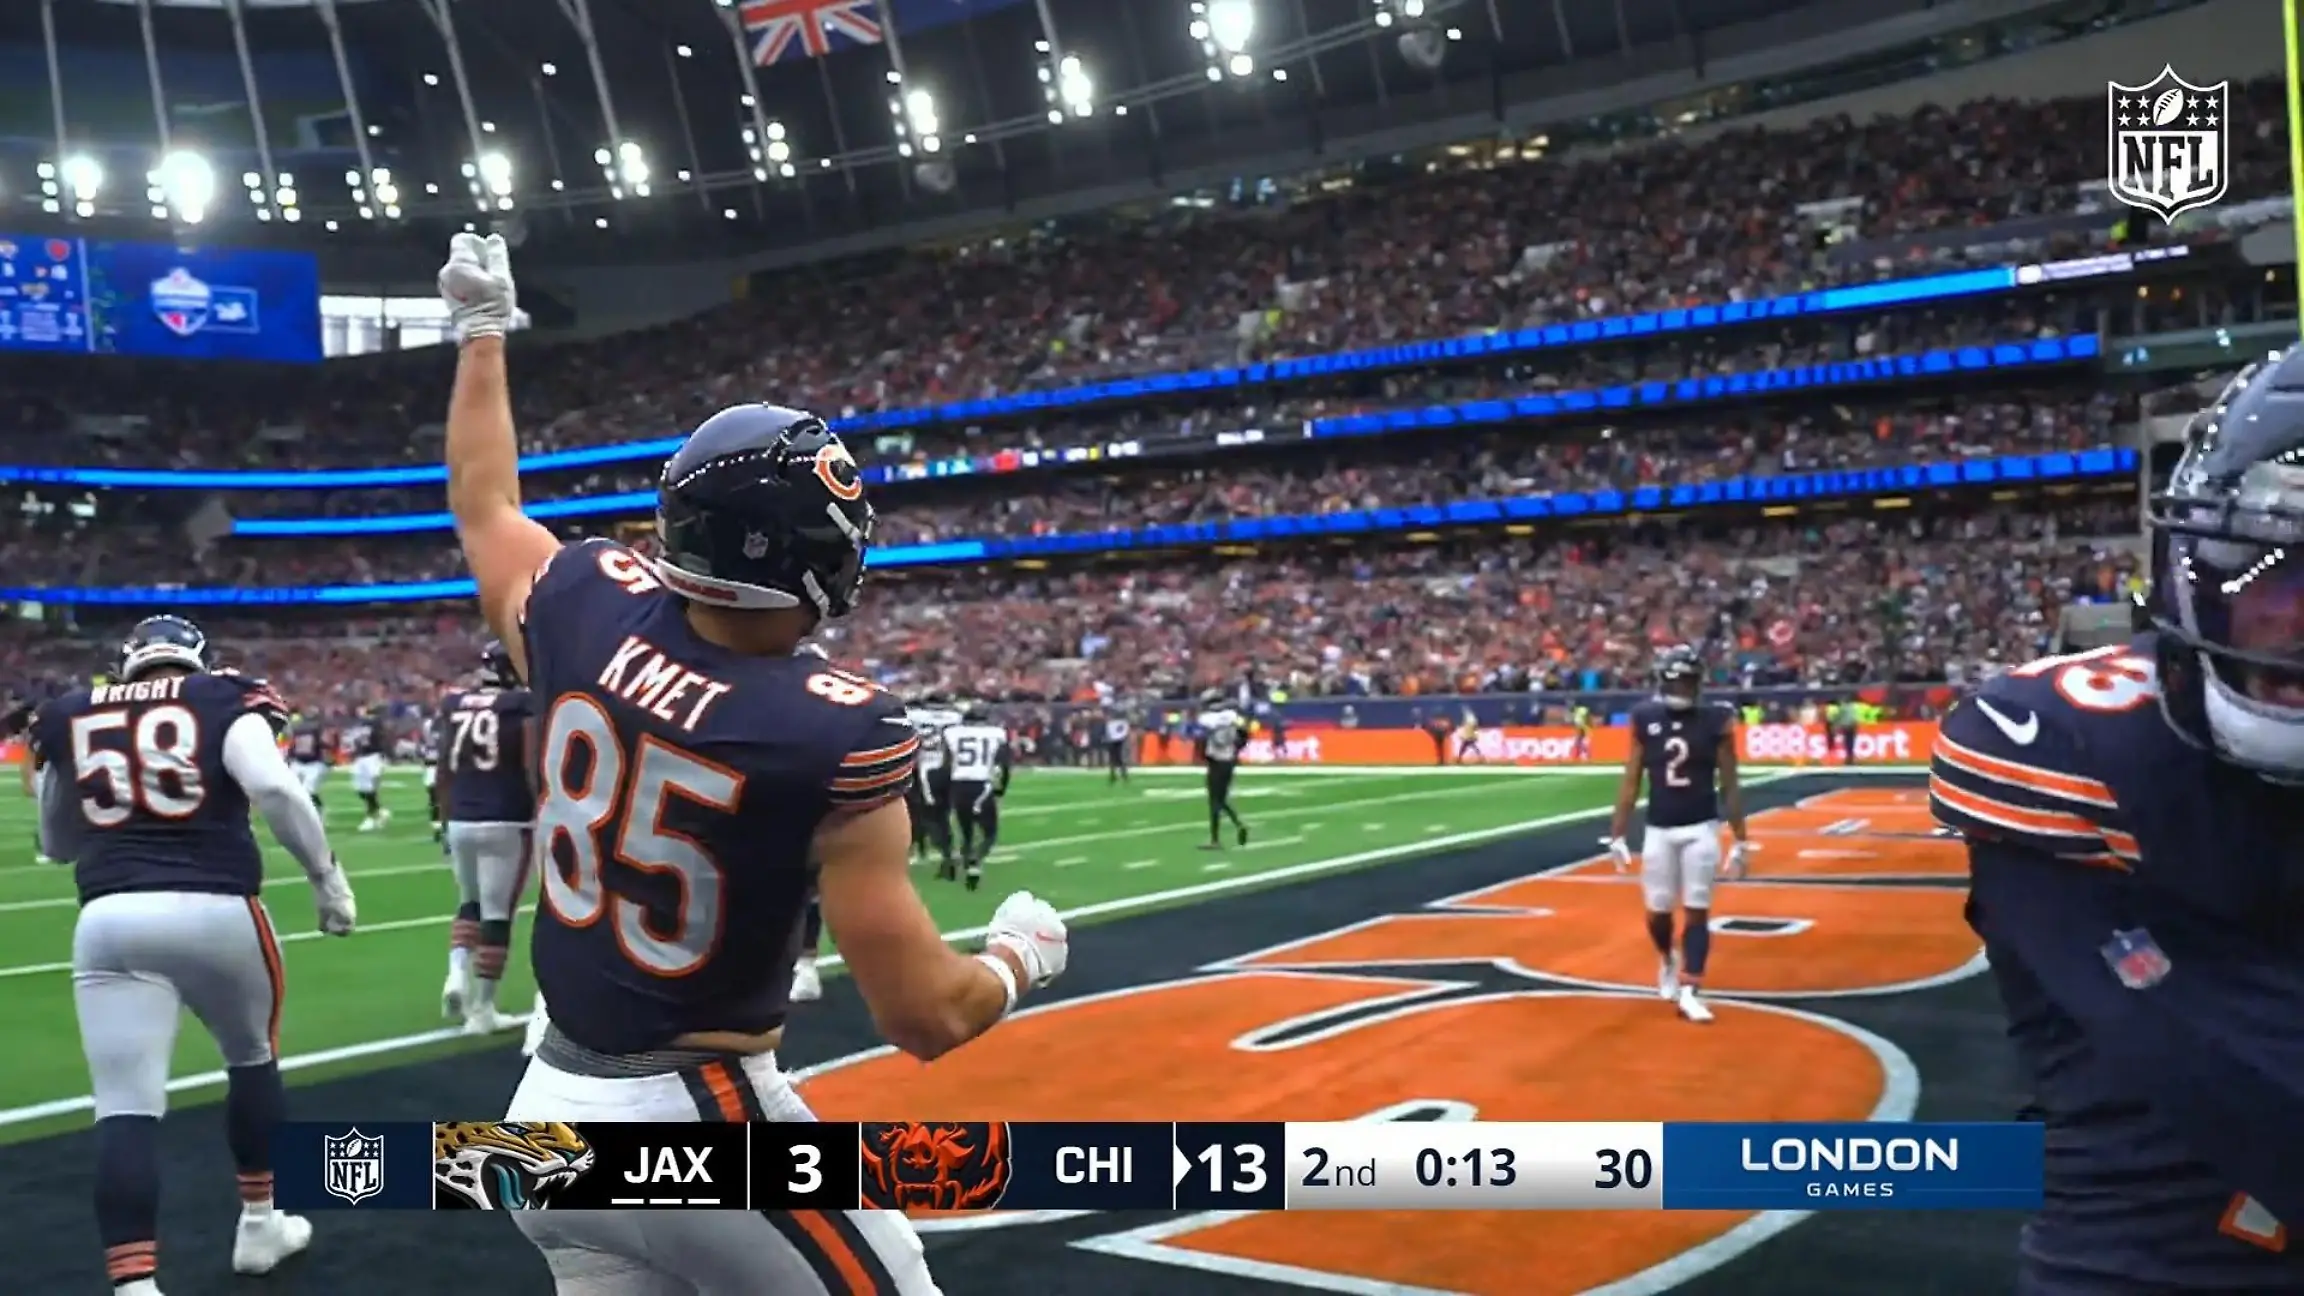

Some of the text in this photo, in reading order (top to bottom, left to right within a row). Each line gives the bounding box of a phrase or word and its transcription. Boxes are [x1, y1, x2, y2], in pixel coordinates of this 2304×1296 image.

[91, 676, 186, 706] WRIGHT
[596, 636, 732, 732] KMET
[70, 702, 206, 829] 58
[449, 708, 499, 773] 79
[957, 736, 990, 767] 51
[1663, 736, 1692, 788] 2
[1746, 724, 1910, 760] 888sort
[538, 690, 747, 979] 85
